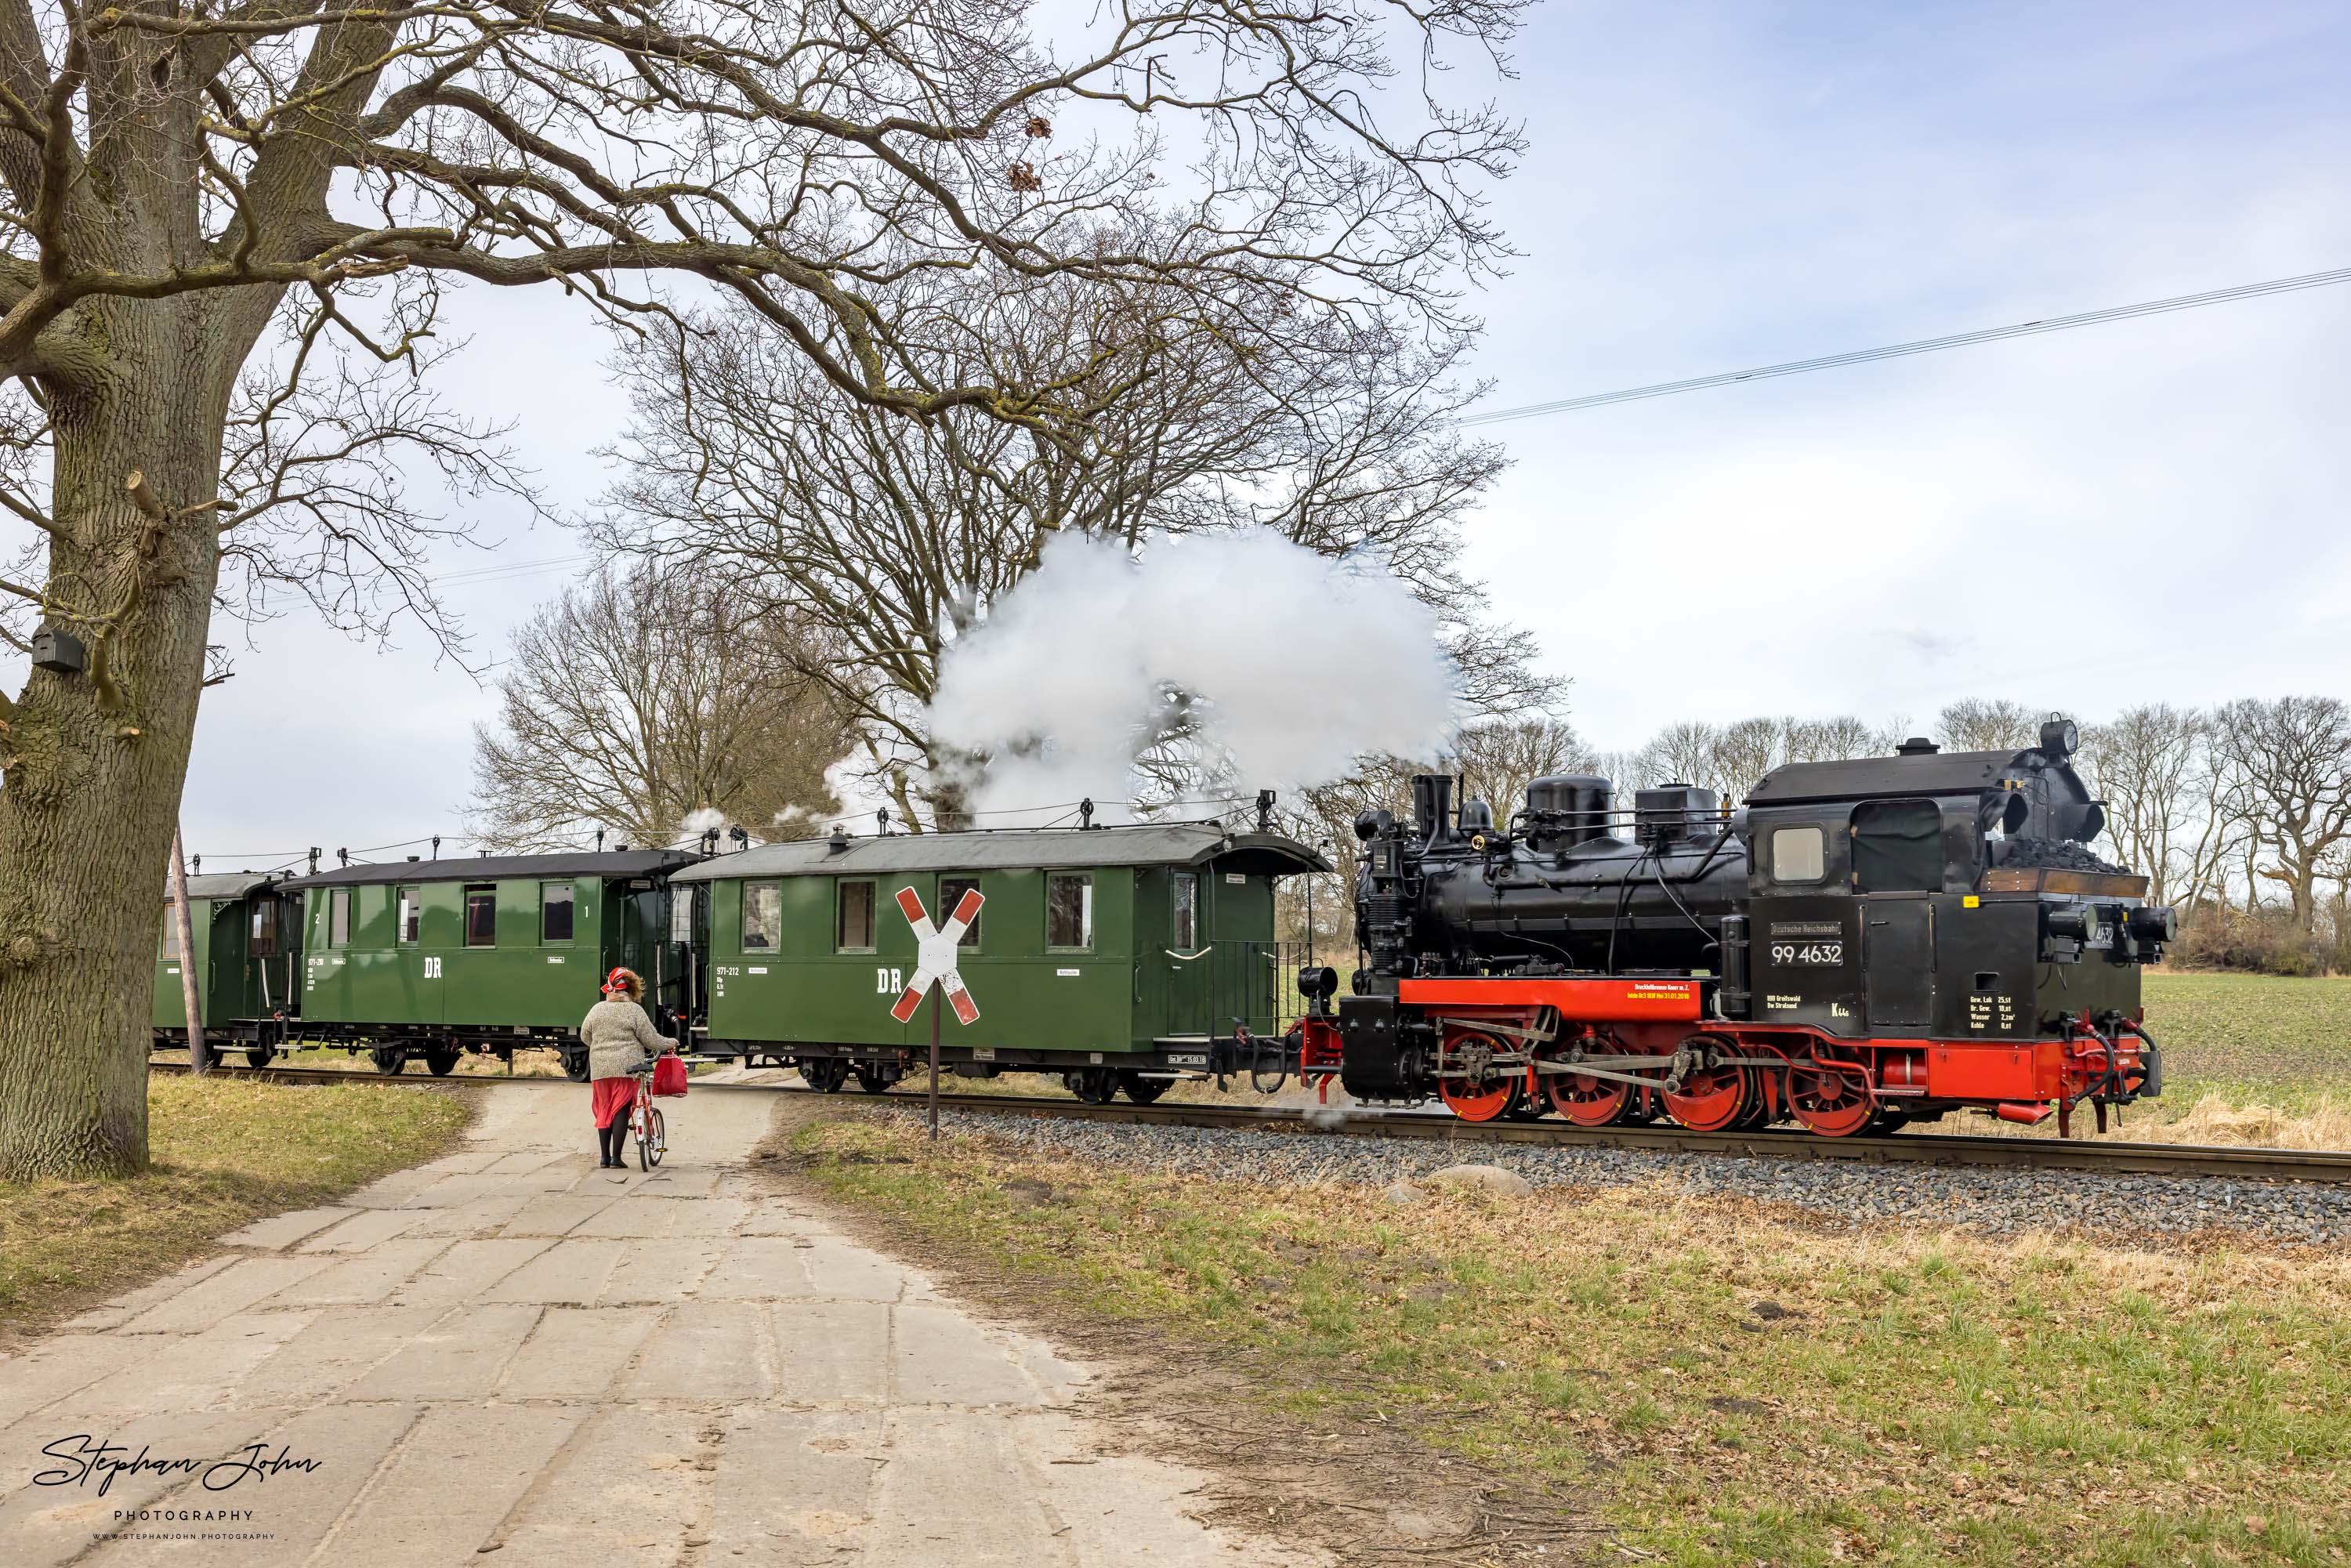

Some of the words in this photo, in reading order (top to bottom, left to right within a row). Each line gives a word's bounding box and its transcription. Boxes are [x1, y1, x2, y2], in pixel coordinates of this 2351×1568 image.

[315, 913, 321, 925] 2
[1803, 924, 1839, 932] Reichsbahn
[2096, 927, 2114, 944] 4632
[1772, 946, 1795, 963] 99
[1798, 945, 1842, 963] 4632
[424, 957, 442, 979] DR
[716, 966, 739, 976] 971-212
[877, 968, 902, 994] DR
